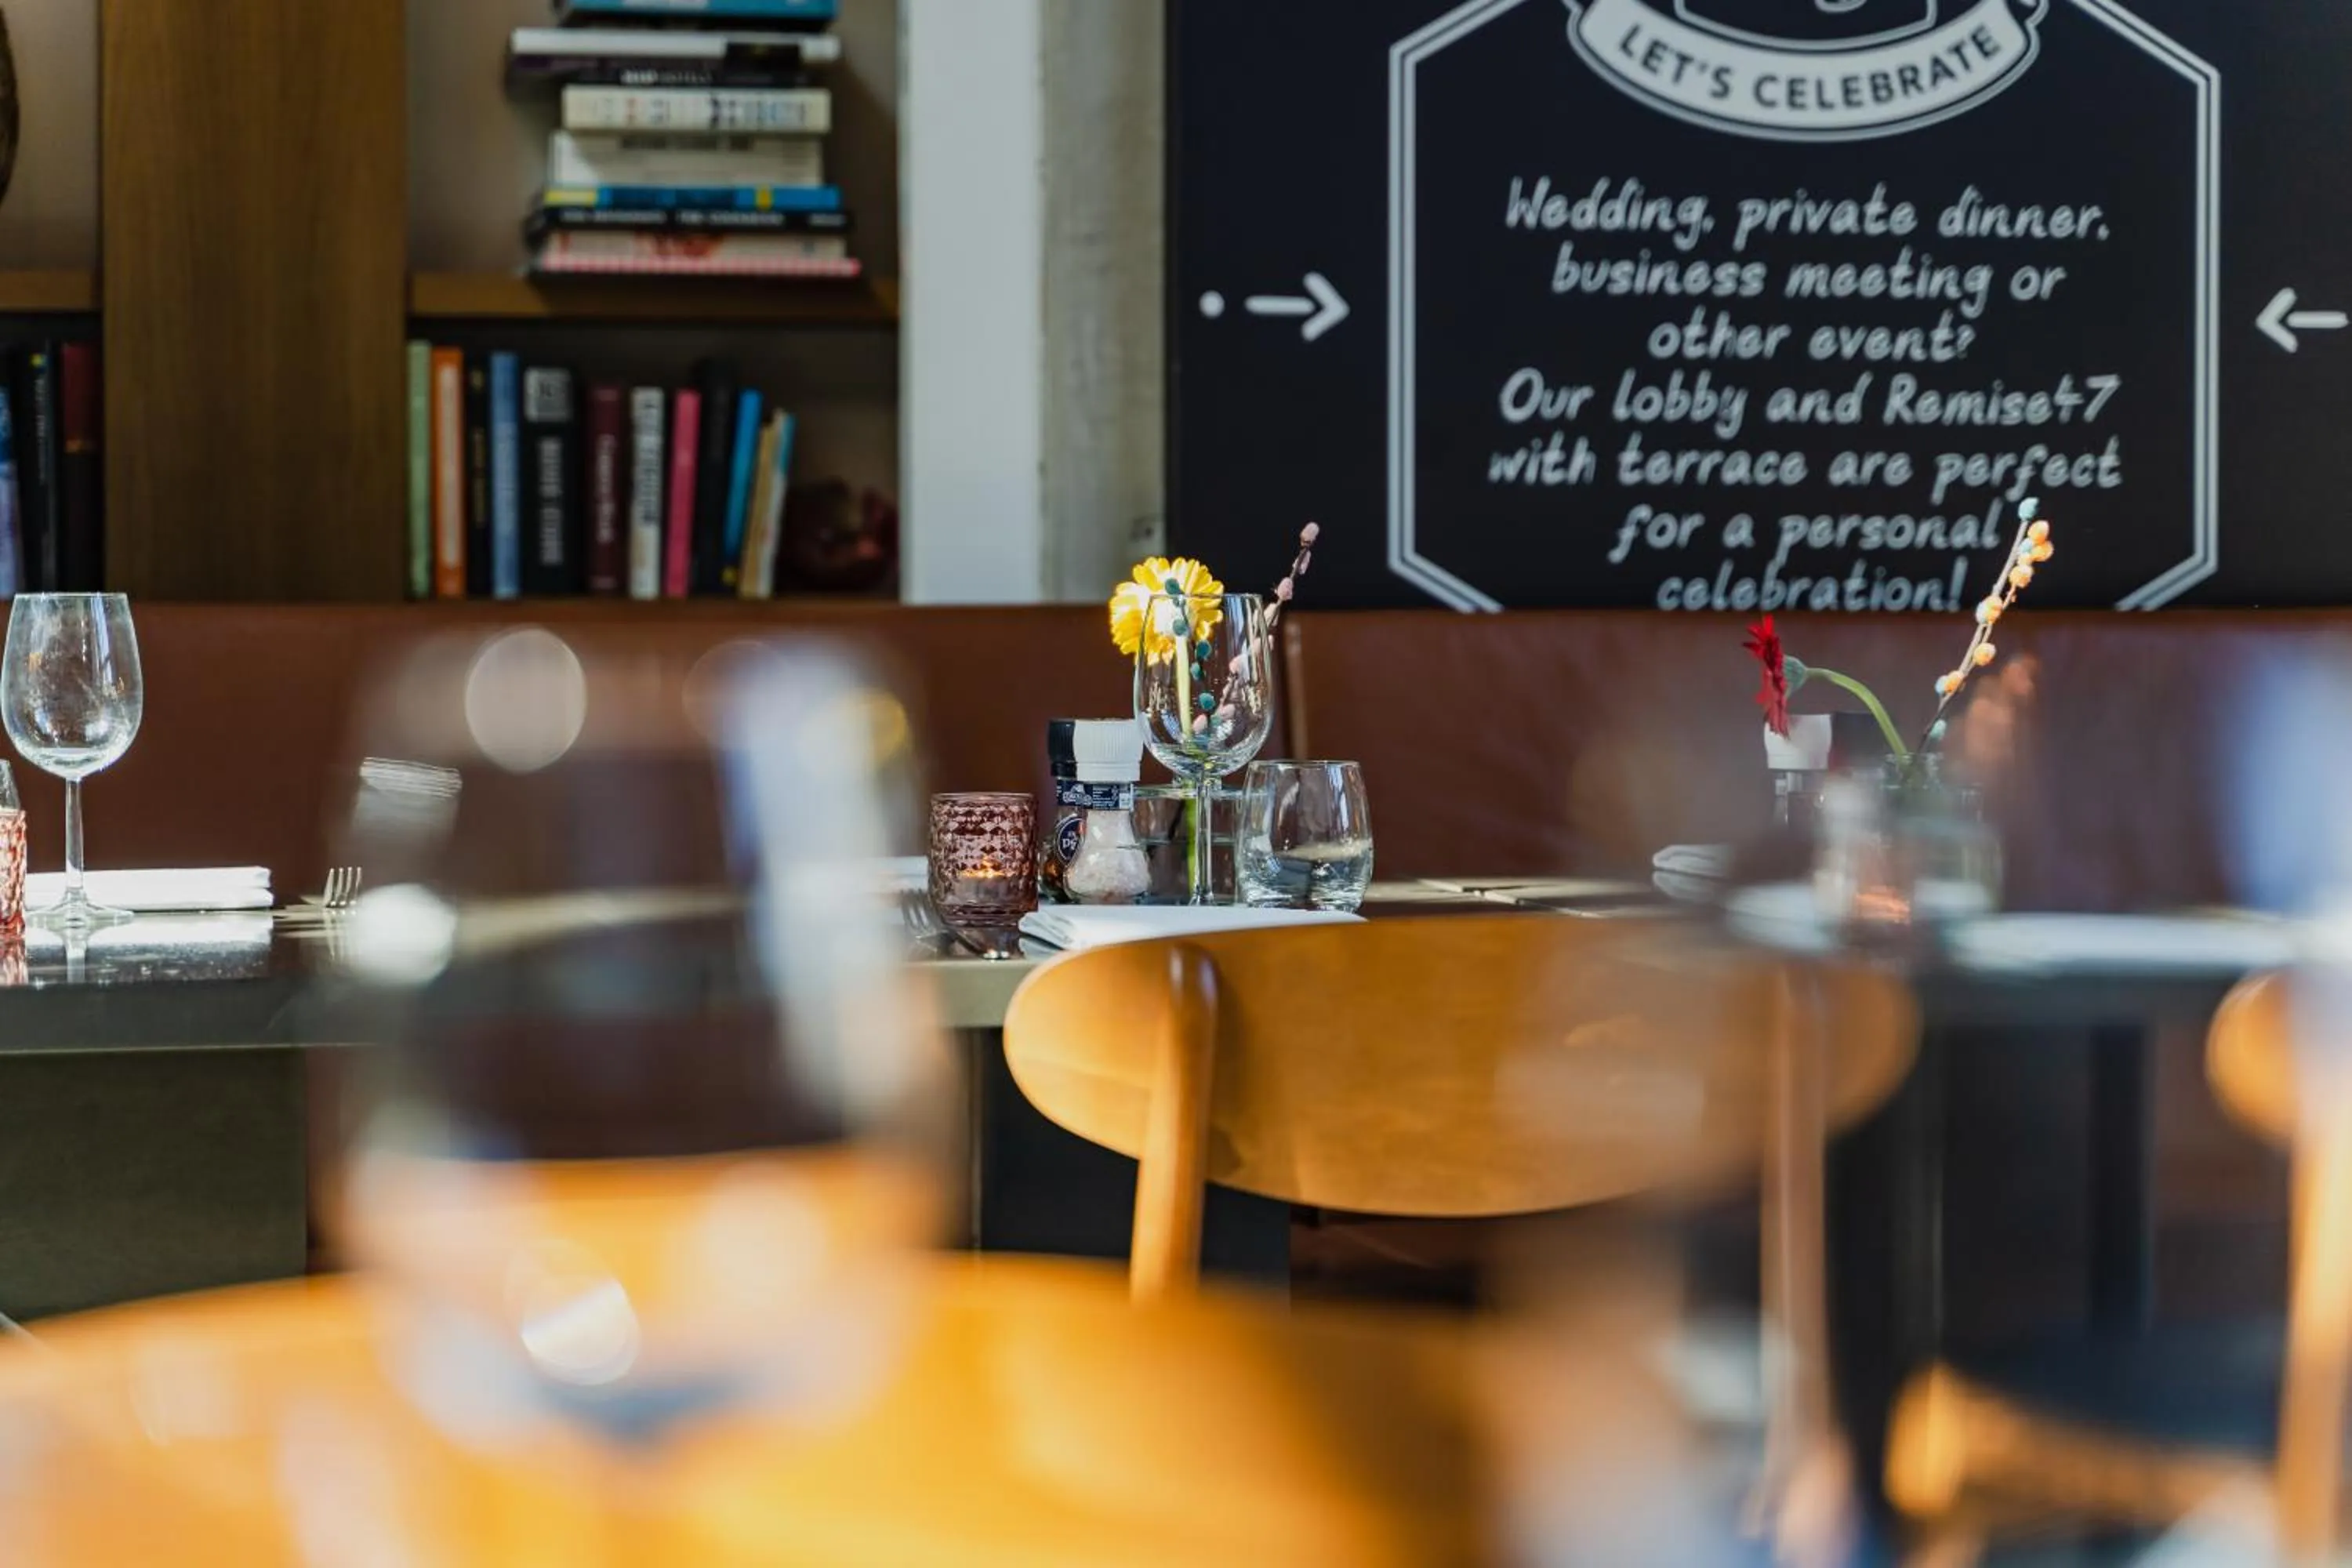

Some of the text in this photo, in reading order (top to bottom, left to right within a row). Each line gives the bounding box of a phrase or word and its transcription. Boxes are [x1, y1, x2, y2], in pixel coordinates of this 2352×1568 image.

[1618, 23, 2002, 111] LET'S CELEBRATE
[1733, 183, 1916, 251] private
[1553, 241, 2065, 318] business meeting or
[1648, 306, 1973, 361] other event?
[1500, 368, 1592, 422] Our
[1613, 369, 1747, 439] lobby
[1767, 372, 1871, 423] and
[1490, 432, 2121, 505] with terrace are perfect
[1609, 498, 2002, 565] for a personal
[1657, 557, 1965, 611] celebration!
